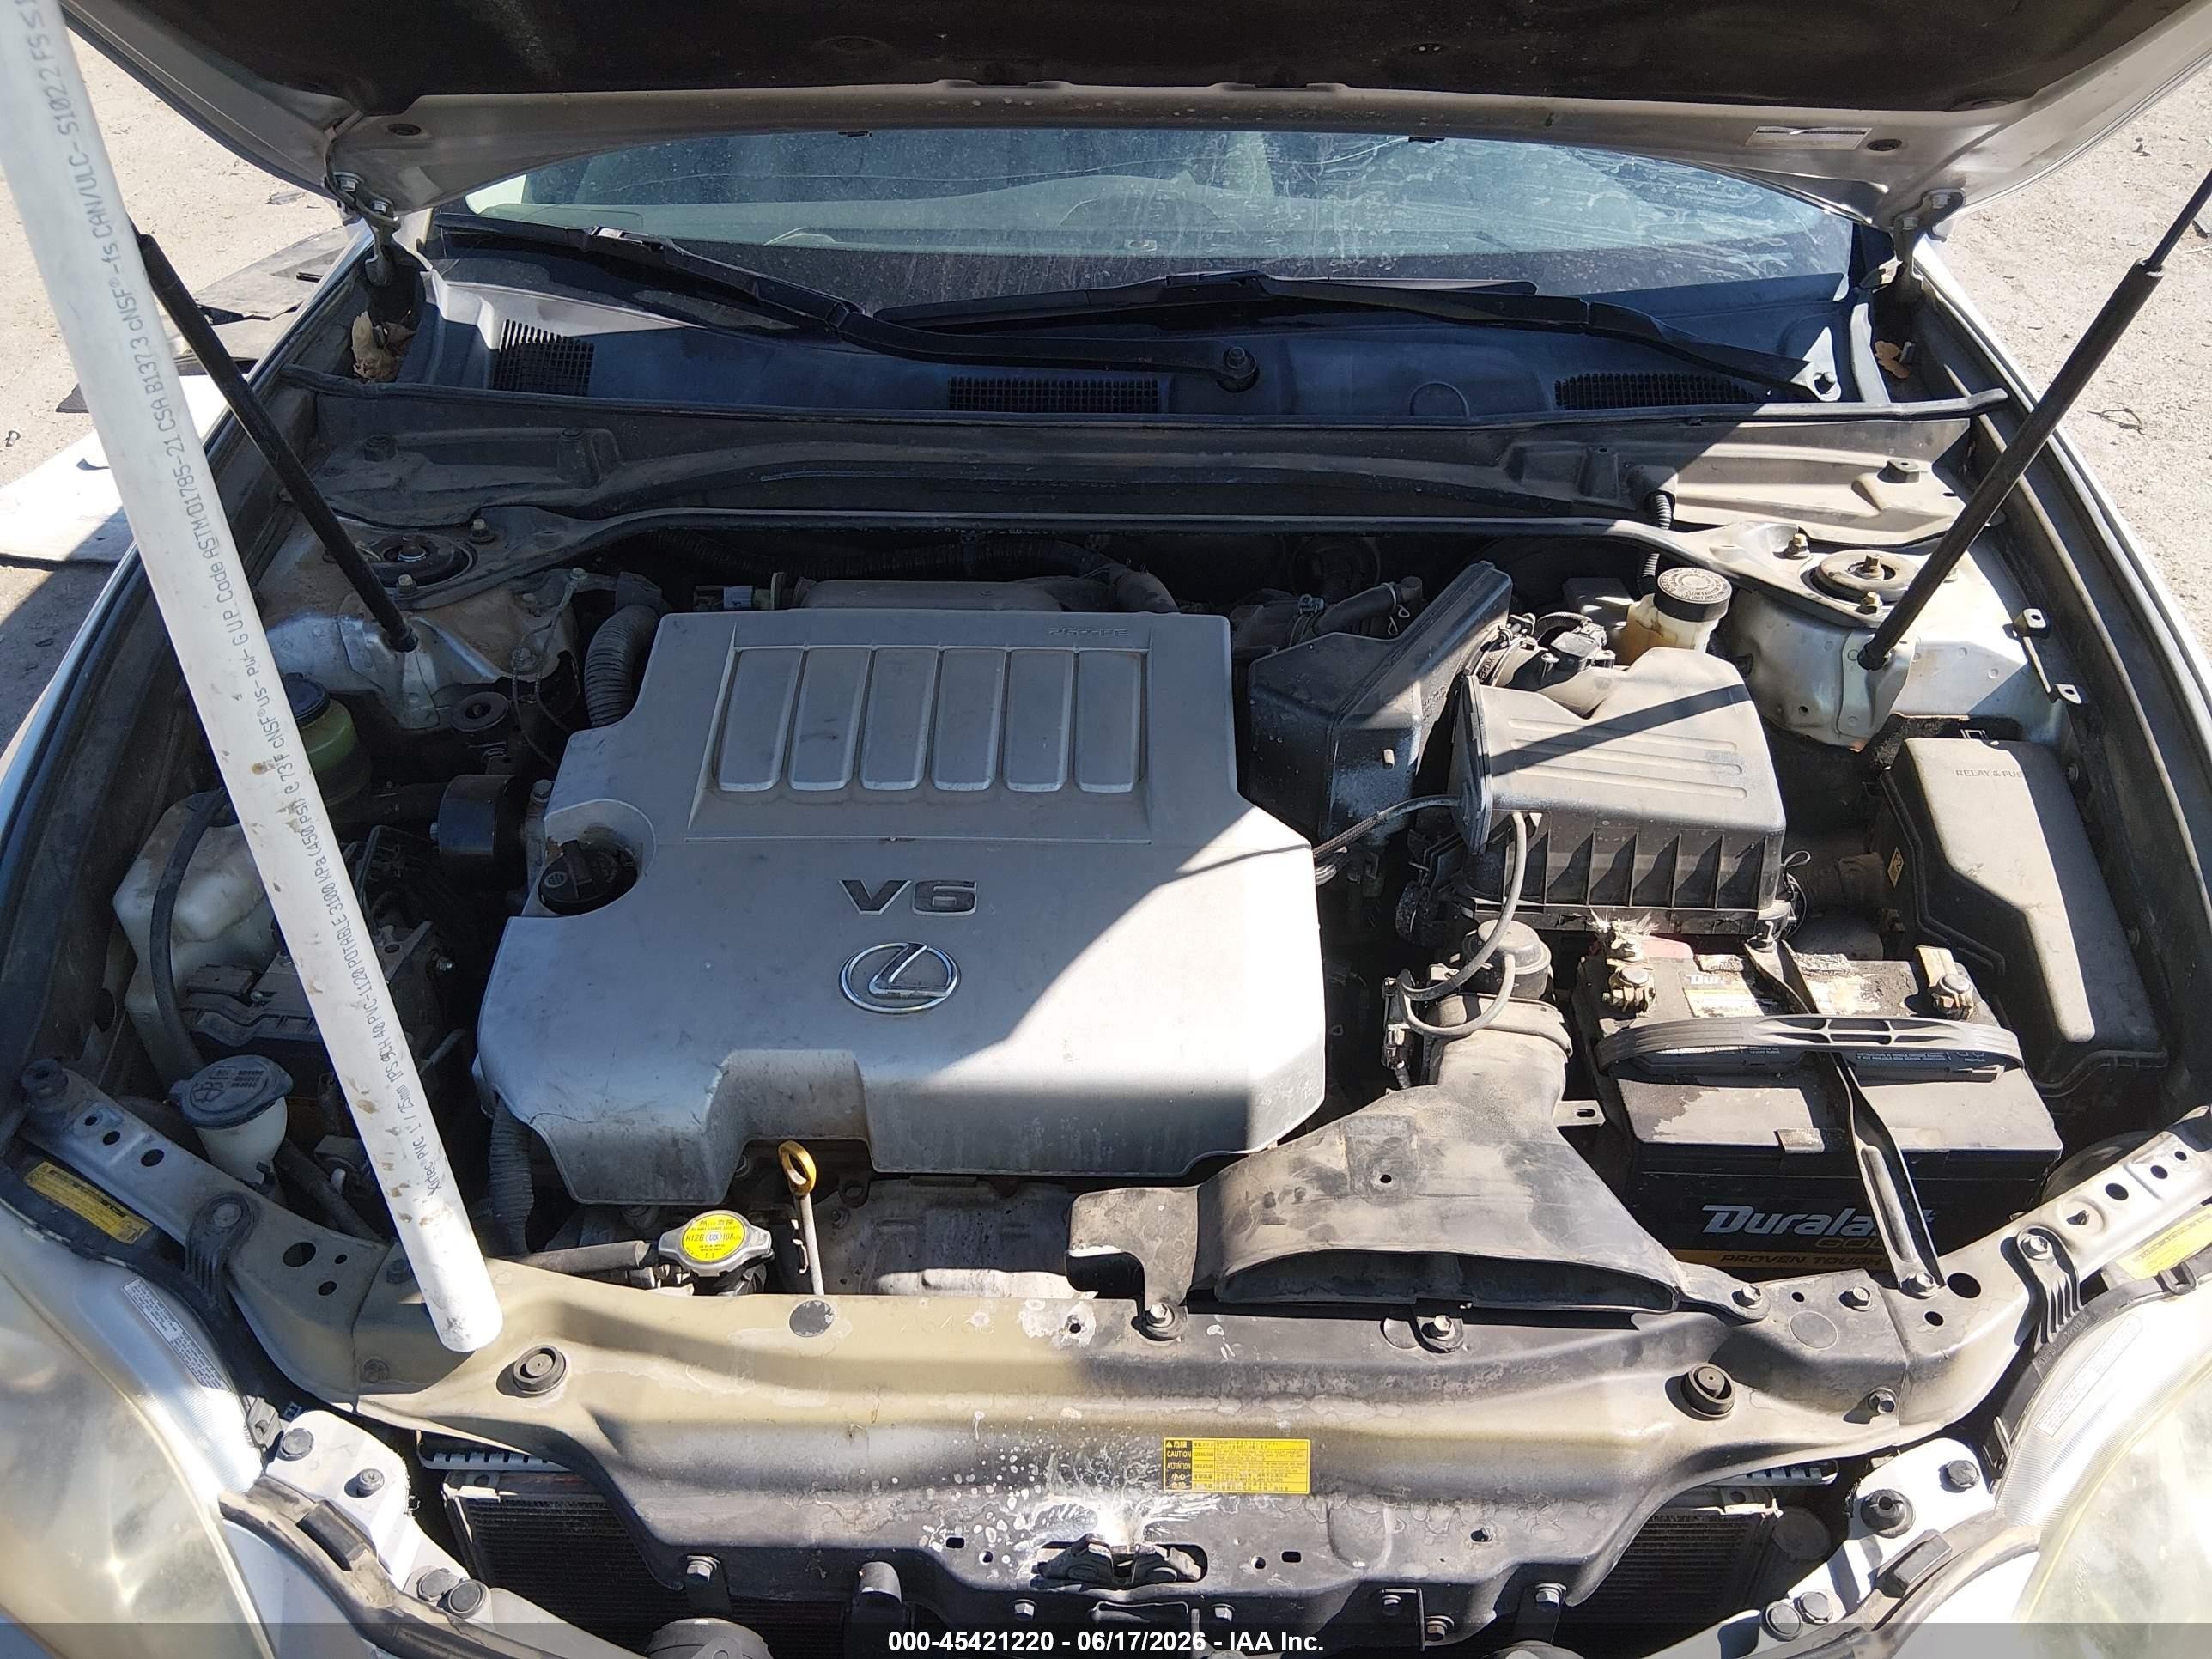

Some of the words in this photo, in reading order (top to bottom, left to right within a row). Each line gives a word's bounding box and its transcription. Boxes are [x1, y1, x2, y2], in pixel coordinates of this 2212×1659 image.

[150, 396, 177, 433] CSA
[190, 515, 221, 560] ASTM
[209, 561, 234, 604] Code
[295, 824, 323, 858] (450
[313, 855, 332, 884] kPa
[320, 882, 343, 916] 3100
[838, 878, 978, 916] V6
[330, 913, 362, 969] POTABLE
[350, 966, 382, 1025] PVC-1120
[371, 1021, 386, 1039] 40
[384, 1060, 404, 1084] IPS
[395, 1084, 415, 1115] 25mm
[411, 1135, 430, 1160] PVC
[1702, 1205, 1936, 1237] Durala
[1814, 1237, 1885, 1249] GOL
[1720, 1254, 1807, 1265] PROVEN
[1814, 1256, 1883, 1266] TOUGH
